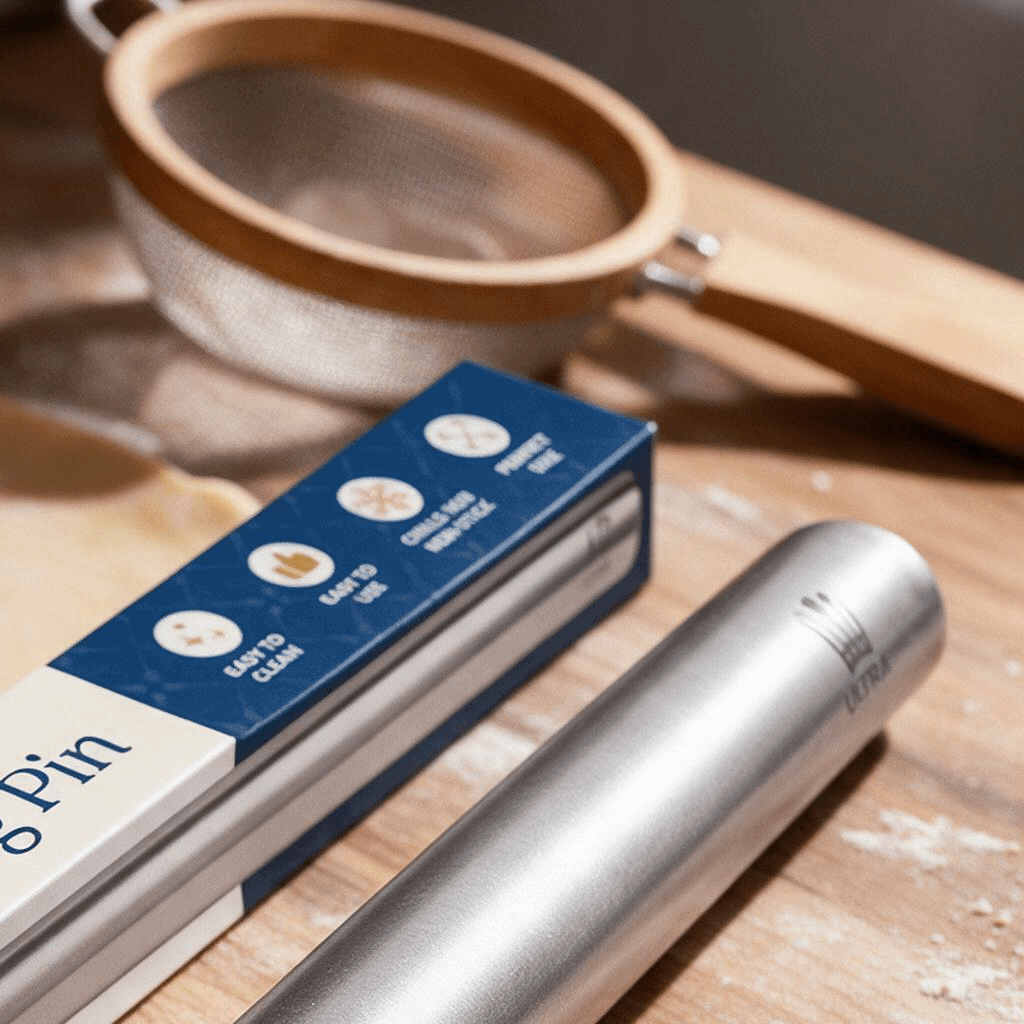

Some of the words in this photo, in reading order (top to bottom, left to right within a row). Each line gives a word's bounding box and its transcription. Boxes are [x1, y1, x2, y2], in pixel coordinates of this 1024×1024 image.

[319, 577, 360, 605] EASY
[350, 563, 378, 580] TO
[223, 647, 266, 678] EASY
[257, 633, 285, 651] TO
[251, 643, 305, 683] CLEAN
